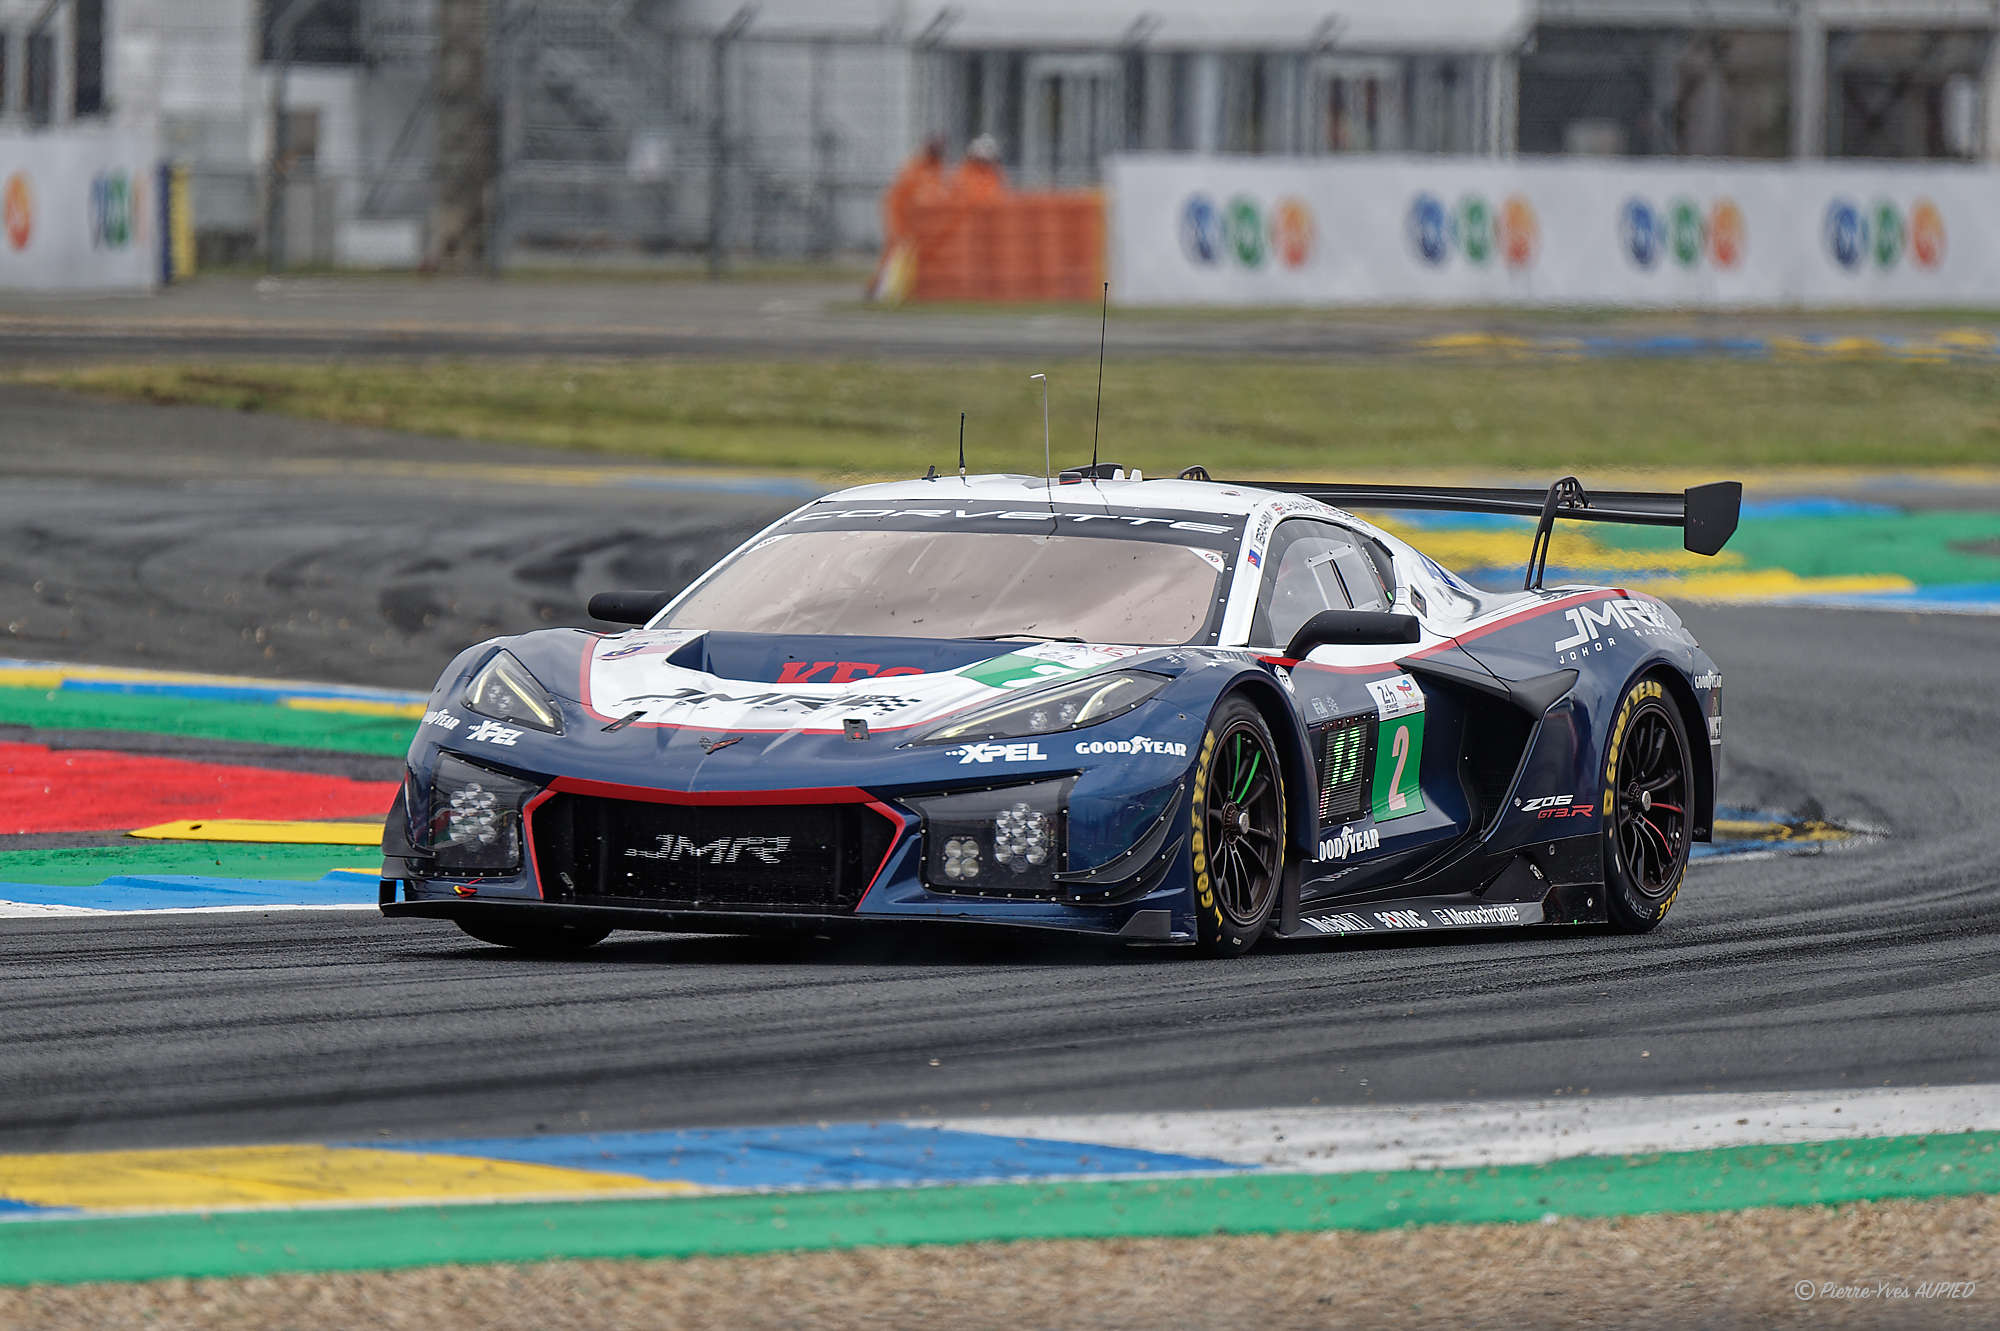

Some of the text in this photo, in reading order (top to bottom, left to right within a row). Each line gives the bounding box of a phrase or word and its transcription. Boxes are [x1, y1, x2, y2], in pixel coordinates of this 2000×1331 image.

[793, 509, 1234, 534] CORVETTE
[1559, 637, 1617, 665] JOHOR
[777, 661, 926, 684] KF
[467, 720, 524, 746] XPEL
[957, 742, 1048, 765] XPEL
[1075, 736, 1187, 757] GOODYEAR
[1388, 725, 1410, 811] 2
[1521, 794, 1574, 812] Z06
[1537, 804, 1594, 819] GT3.R
[624, 834, 792, 864] JMR
[1319, 825, 1380, 861] OODYEAR
[1447, 904, 1519, 926] Monochrome
